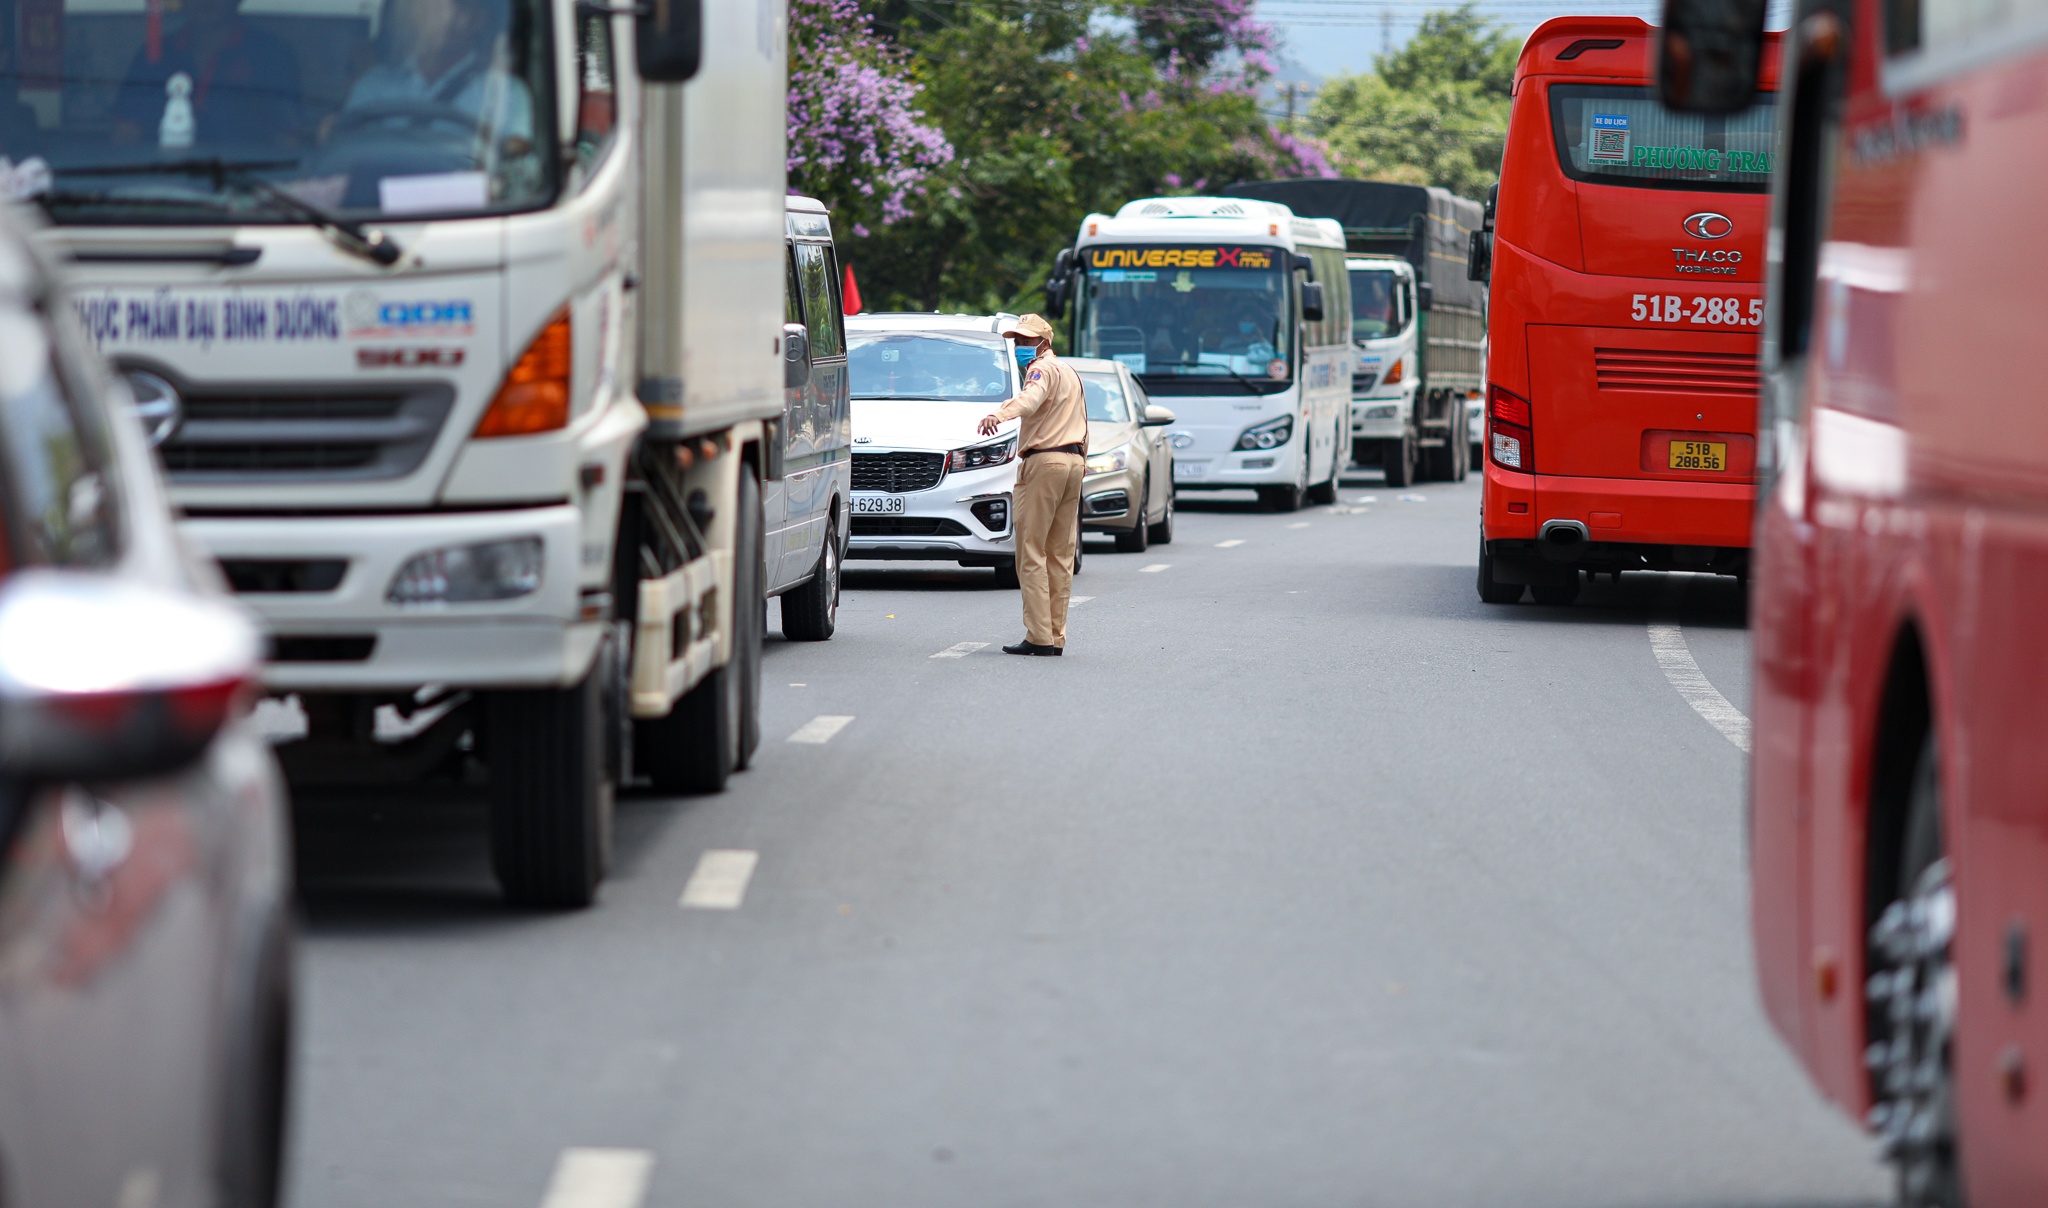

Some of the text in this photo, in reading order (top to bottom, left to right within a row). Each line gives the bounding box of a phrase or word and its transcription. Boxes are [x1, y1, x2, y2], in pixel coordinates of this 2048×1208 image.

[1595, 117, 1603, 125] XE
[1613, 118, 1628, 127] LỊCH
[1632, 145, 1720, 171] PHƯƠNG
[1672, 248, 1742, 263] THACO
[1675, 265, 1737, 275] MOBIHOME
[1686, 443, 1710, 455] 51B
[1675, 456, 1719, 469] 288.56
